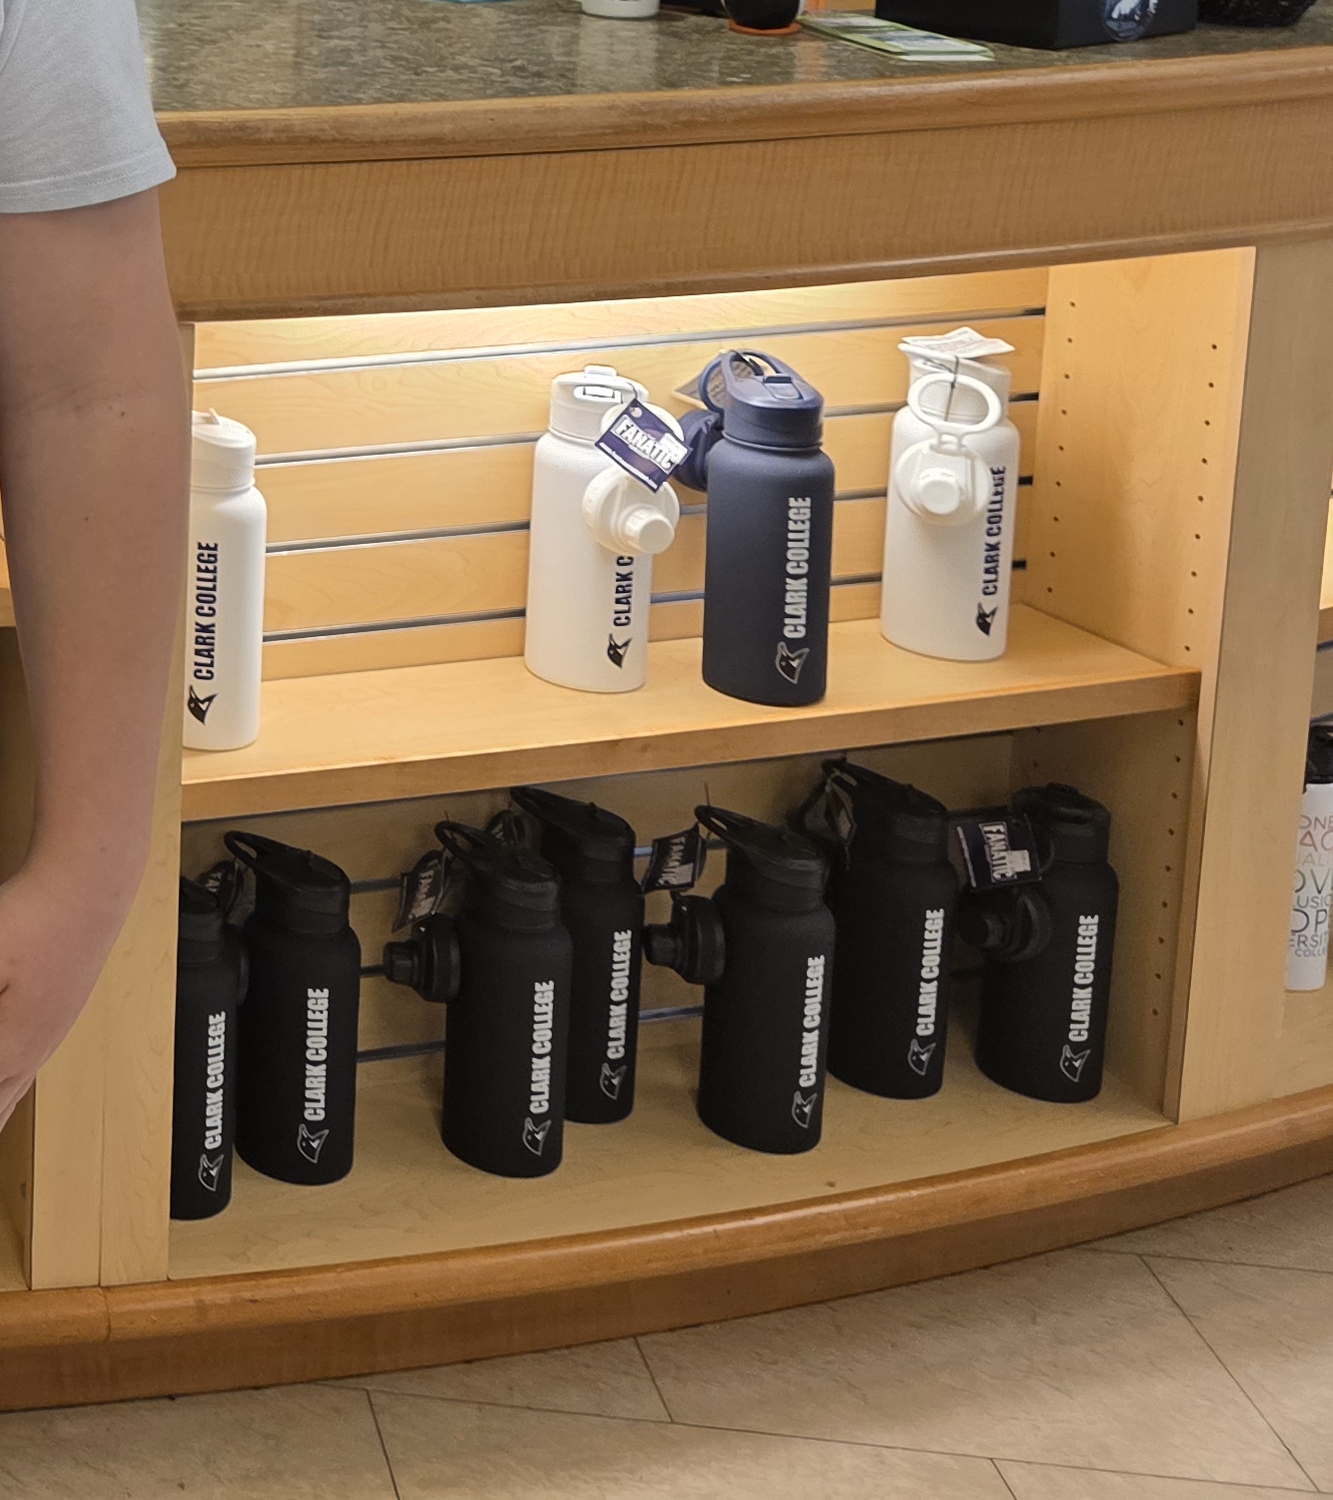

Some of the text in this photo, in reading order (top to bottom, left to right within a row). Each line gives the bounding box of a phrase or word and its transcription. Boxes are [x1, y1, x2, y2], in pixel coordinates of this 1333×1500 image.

[614, 418, 677, 471] FANATIC
[783, 497, 812, 639] CLARK COLLEGE
[981, 466, 1007, 597] CLARK COLLEGE
[193, 541, 219, 681] CLARK COLLEGE
[613, 571, 632, 627] CLARK
[982, 824, 1013, 880] FANATIC
[606, 929, 632, 1060] CLARK COLLEGE
[798, 954, 826, 1088] CLARK COLLEGE
[915, 908, 945, 1036] CLARK COLLEGE
[1068, 914, 1099, 1042] CLARK COLLEGE
[204, 1011, 227, 1150] CLARK COLLEGE
[303, 988, 331, 1121] CLARK COLLEGE
[528, 980, 555, 1114] CLARK COLLEGE
